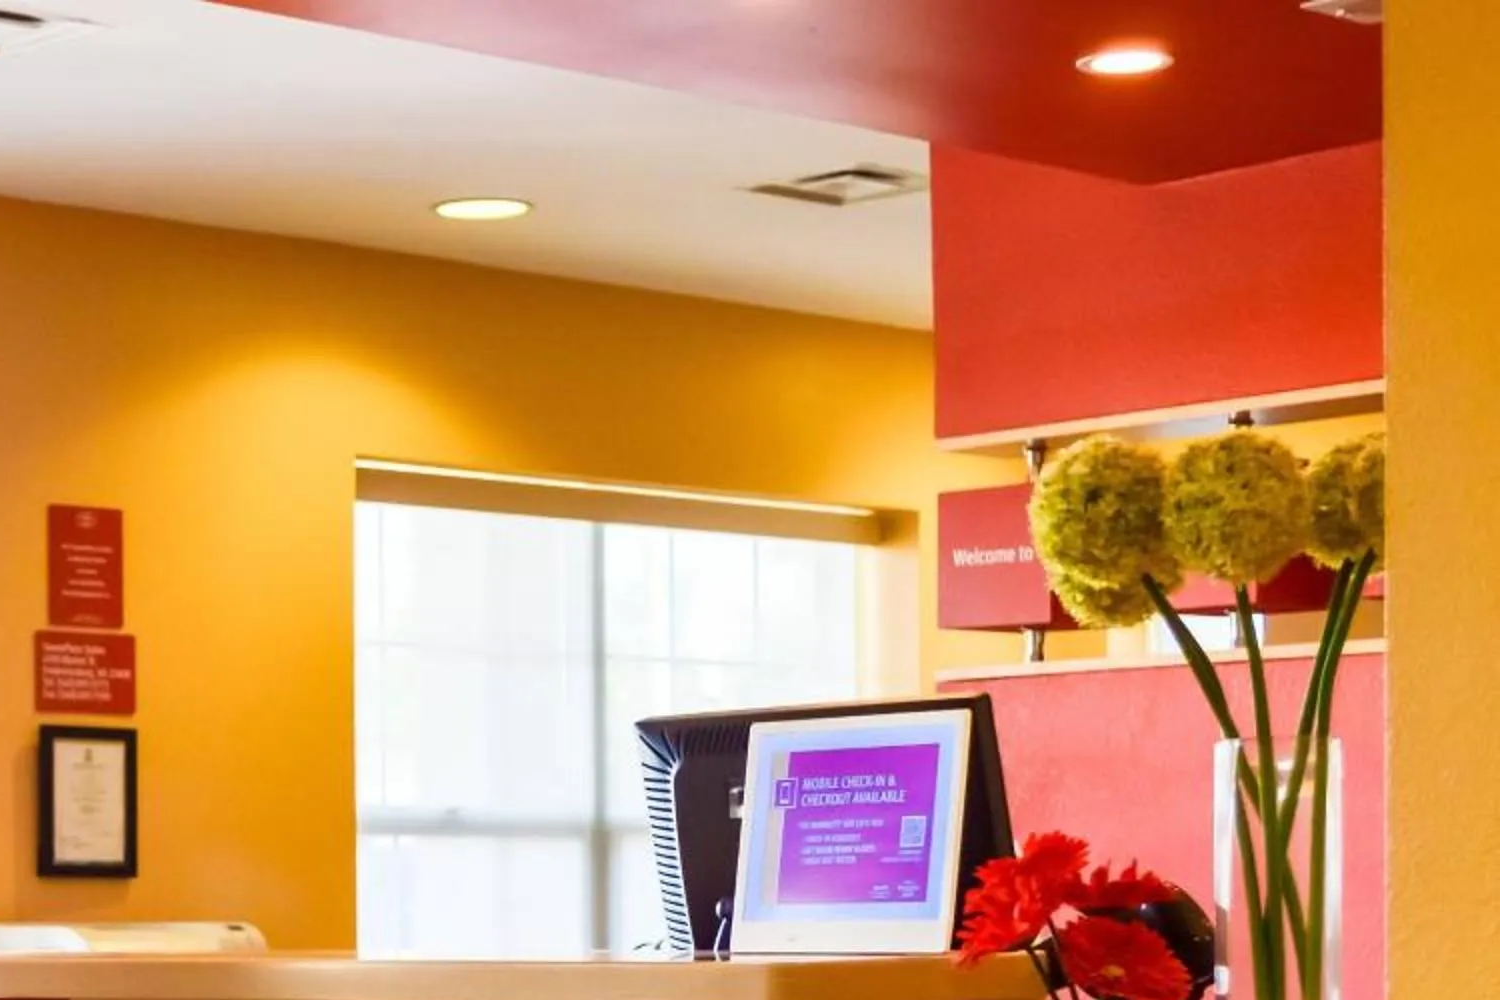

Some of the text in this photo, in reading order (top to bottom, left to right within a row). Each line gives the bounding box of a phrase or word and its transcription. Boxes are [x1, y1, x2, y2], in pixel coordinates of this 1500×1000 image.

[953, 545, 1034, 567] Welcome to
[802, 777, 839, 791] MOBILE
[801, 789, 908, 807] CHECKOUT AVAILABLE
